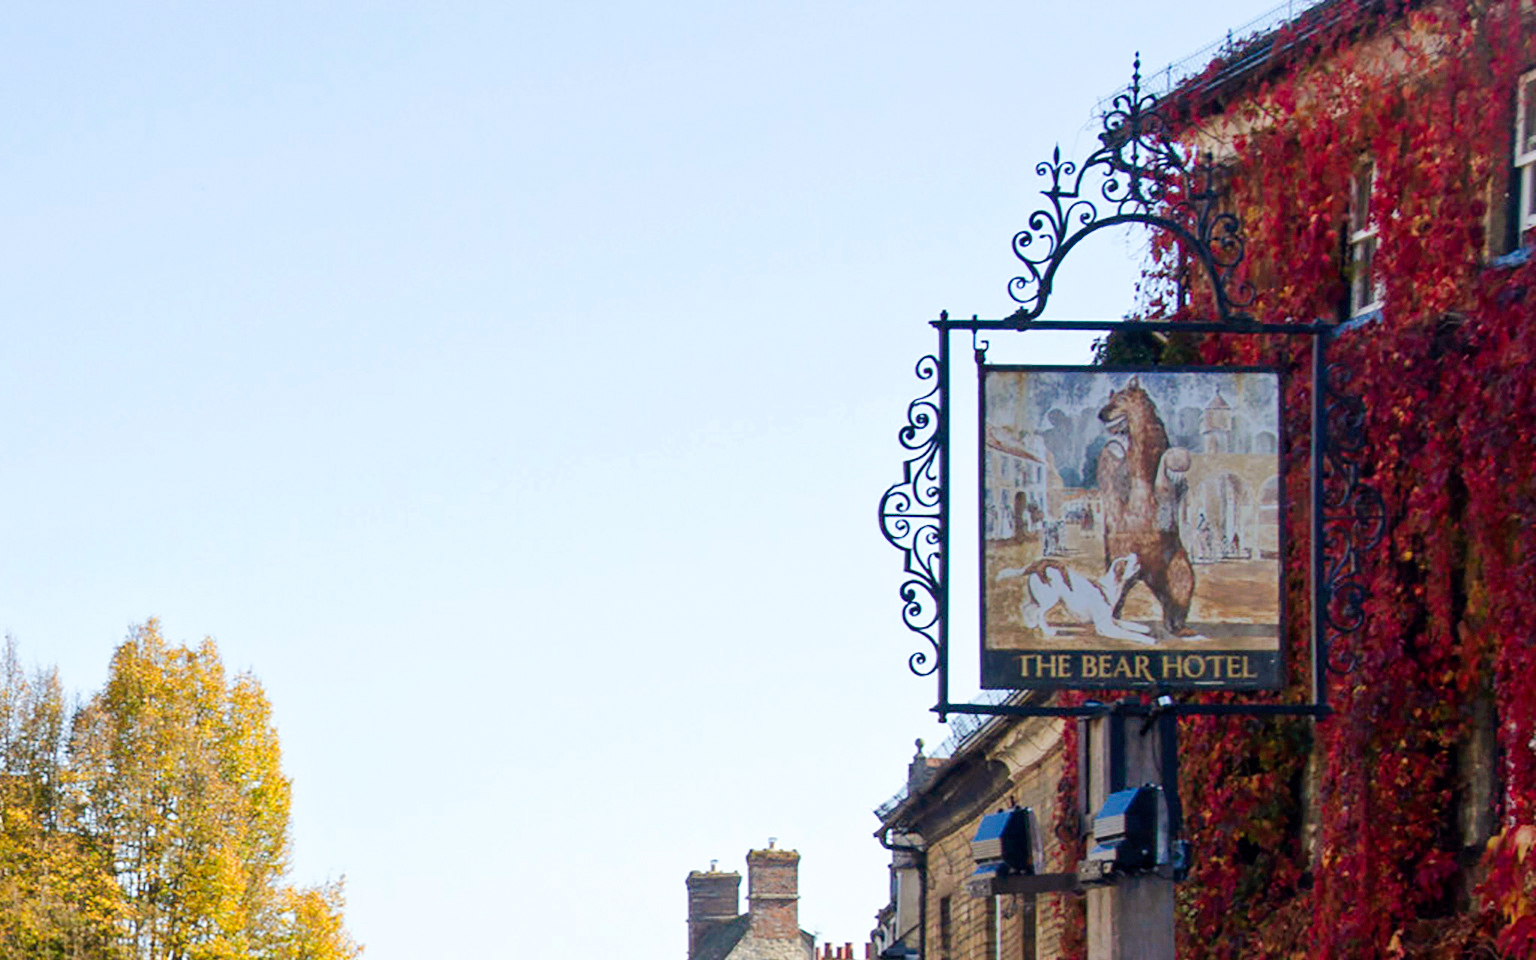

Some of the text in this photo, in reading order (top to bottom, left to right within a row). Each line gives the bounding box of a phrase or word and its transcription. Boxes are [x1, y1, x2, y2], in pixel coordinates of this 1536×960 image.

[1019, 654, 1258, 681] THE BEAR HOTEL
